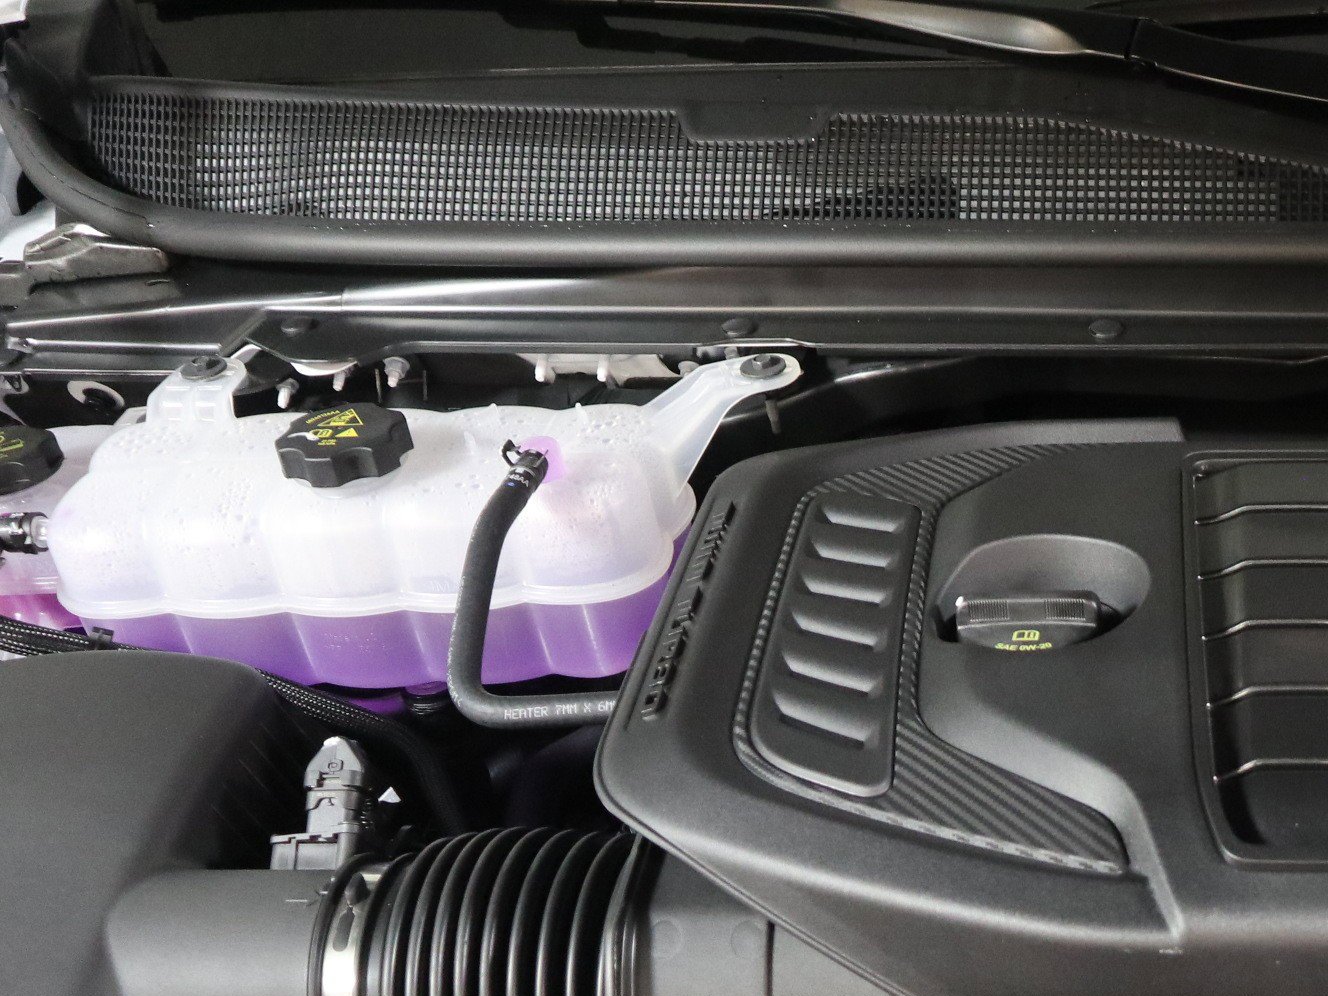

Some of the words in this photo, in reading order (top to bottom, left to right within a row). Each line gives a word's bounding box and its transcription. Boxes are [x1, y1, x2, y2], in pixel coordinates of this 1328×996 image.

[995, 642, 1018, 651] SAE
[503, 706, 548, 720] HEATER
[583, 702, 592, 713] X
